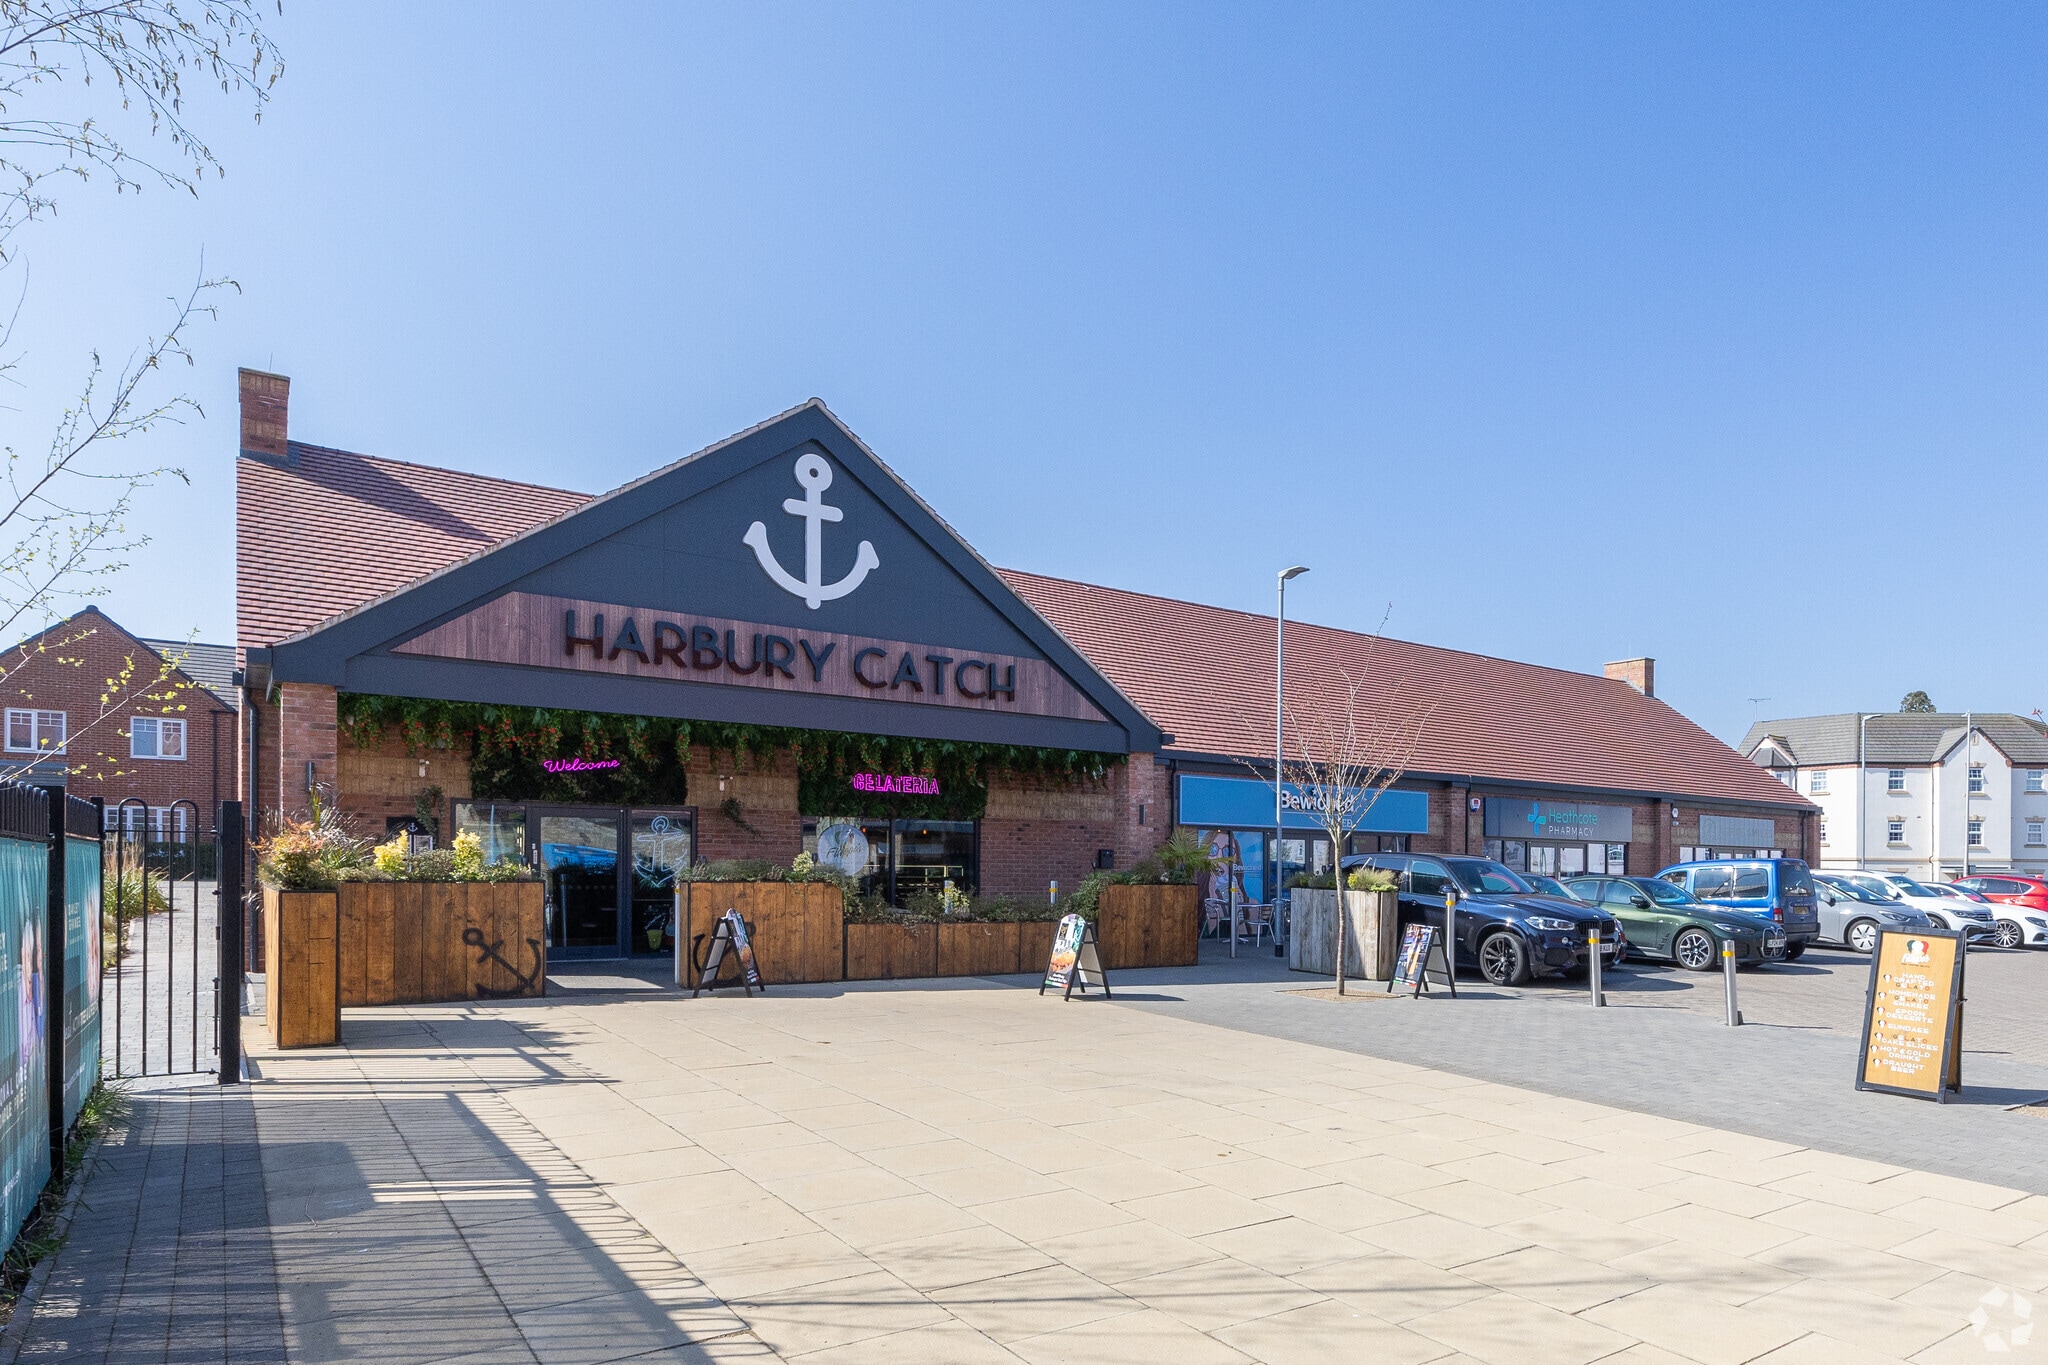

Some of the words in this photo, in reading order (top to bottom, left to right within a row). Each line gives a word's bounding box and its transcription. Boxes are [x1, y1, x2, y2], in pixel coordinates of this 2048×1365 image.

[564, 609, 836, 682] HARBURY
[853, 646, 1016, 702] CATCH
[543, 758, 620, 773] Welcome
[853, 773, 940, 795] GELATERIA
[1548, 808, 1599, 825] Heathcote
[1548, 825, 1595, 837] PHARMACY
[1893, 976, 1935, 987] CRAFTED
[1902, 972, 1926, 981] HAND
[1895, 982, 1931, 991] GELATO
[1888, 989, 1936, 1000] HOMEMADE
[1894, 995, 1930, 1004] GELATO
[1893, 1000, 1929, 1010] SHAKES
[1886, 1012, 1934, 1024] DESSERTS
[1895, 1008, 1926, 1017] SPOON
[1887, 1023, 1930, 1034] SUNDAES
[1881, 1037, 1905, 1046] CAKE
[1905, 1041, 1939, 1051] SLICES
[1892, 1034, 1928, 1044] GELATO
[1888, 1052, 1921, 1062] DRINKS
[1906, 1049, 1931, 1058] COLD
[1882, 1058, 1925, 1070] DRAUGHT
[1891, 1066, 1915, 1075] BEER
